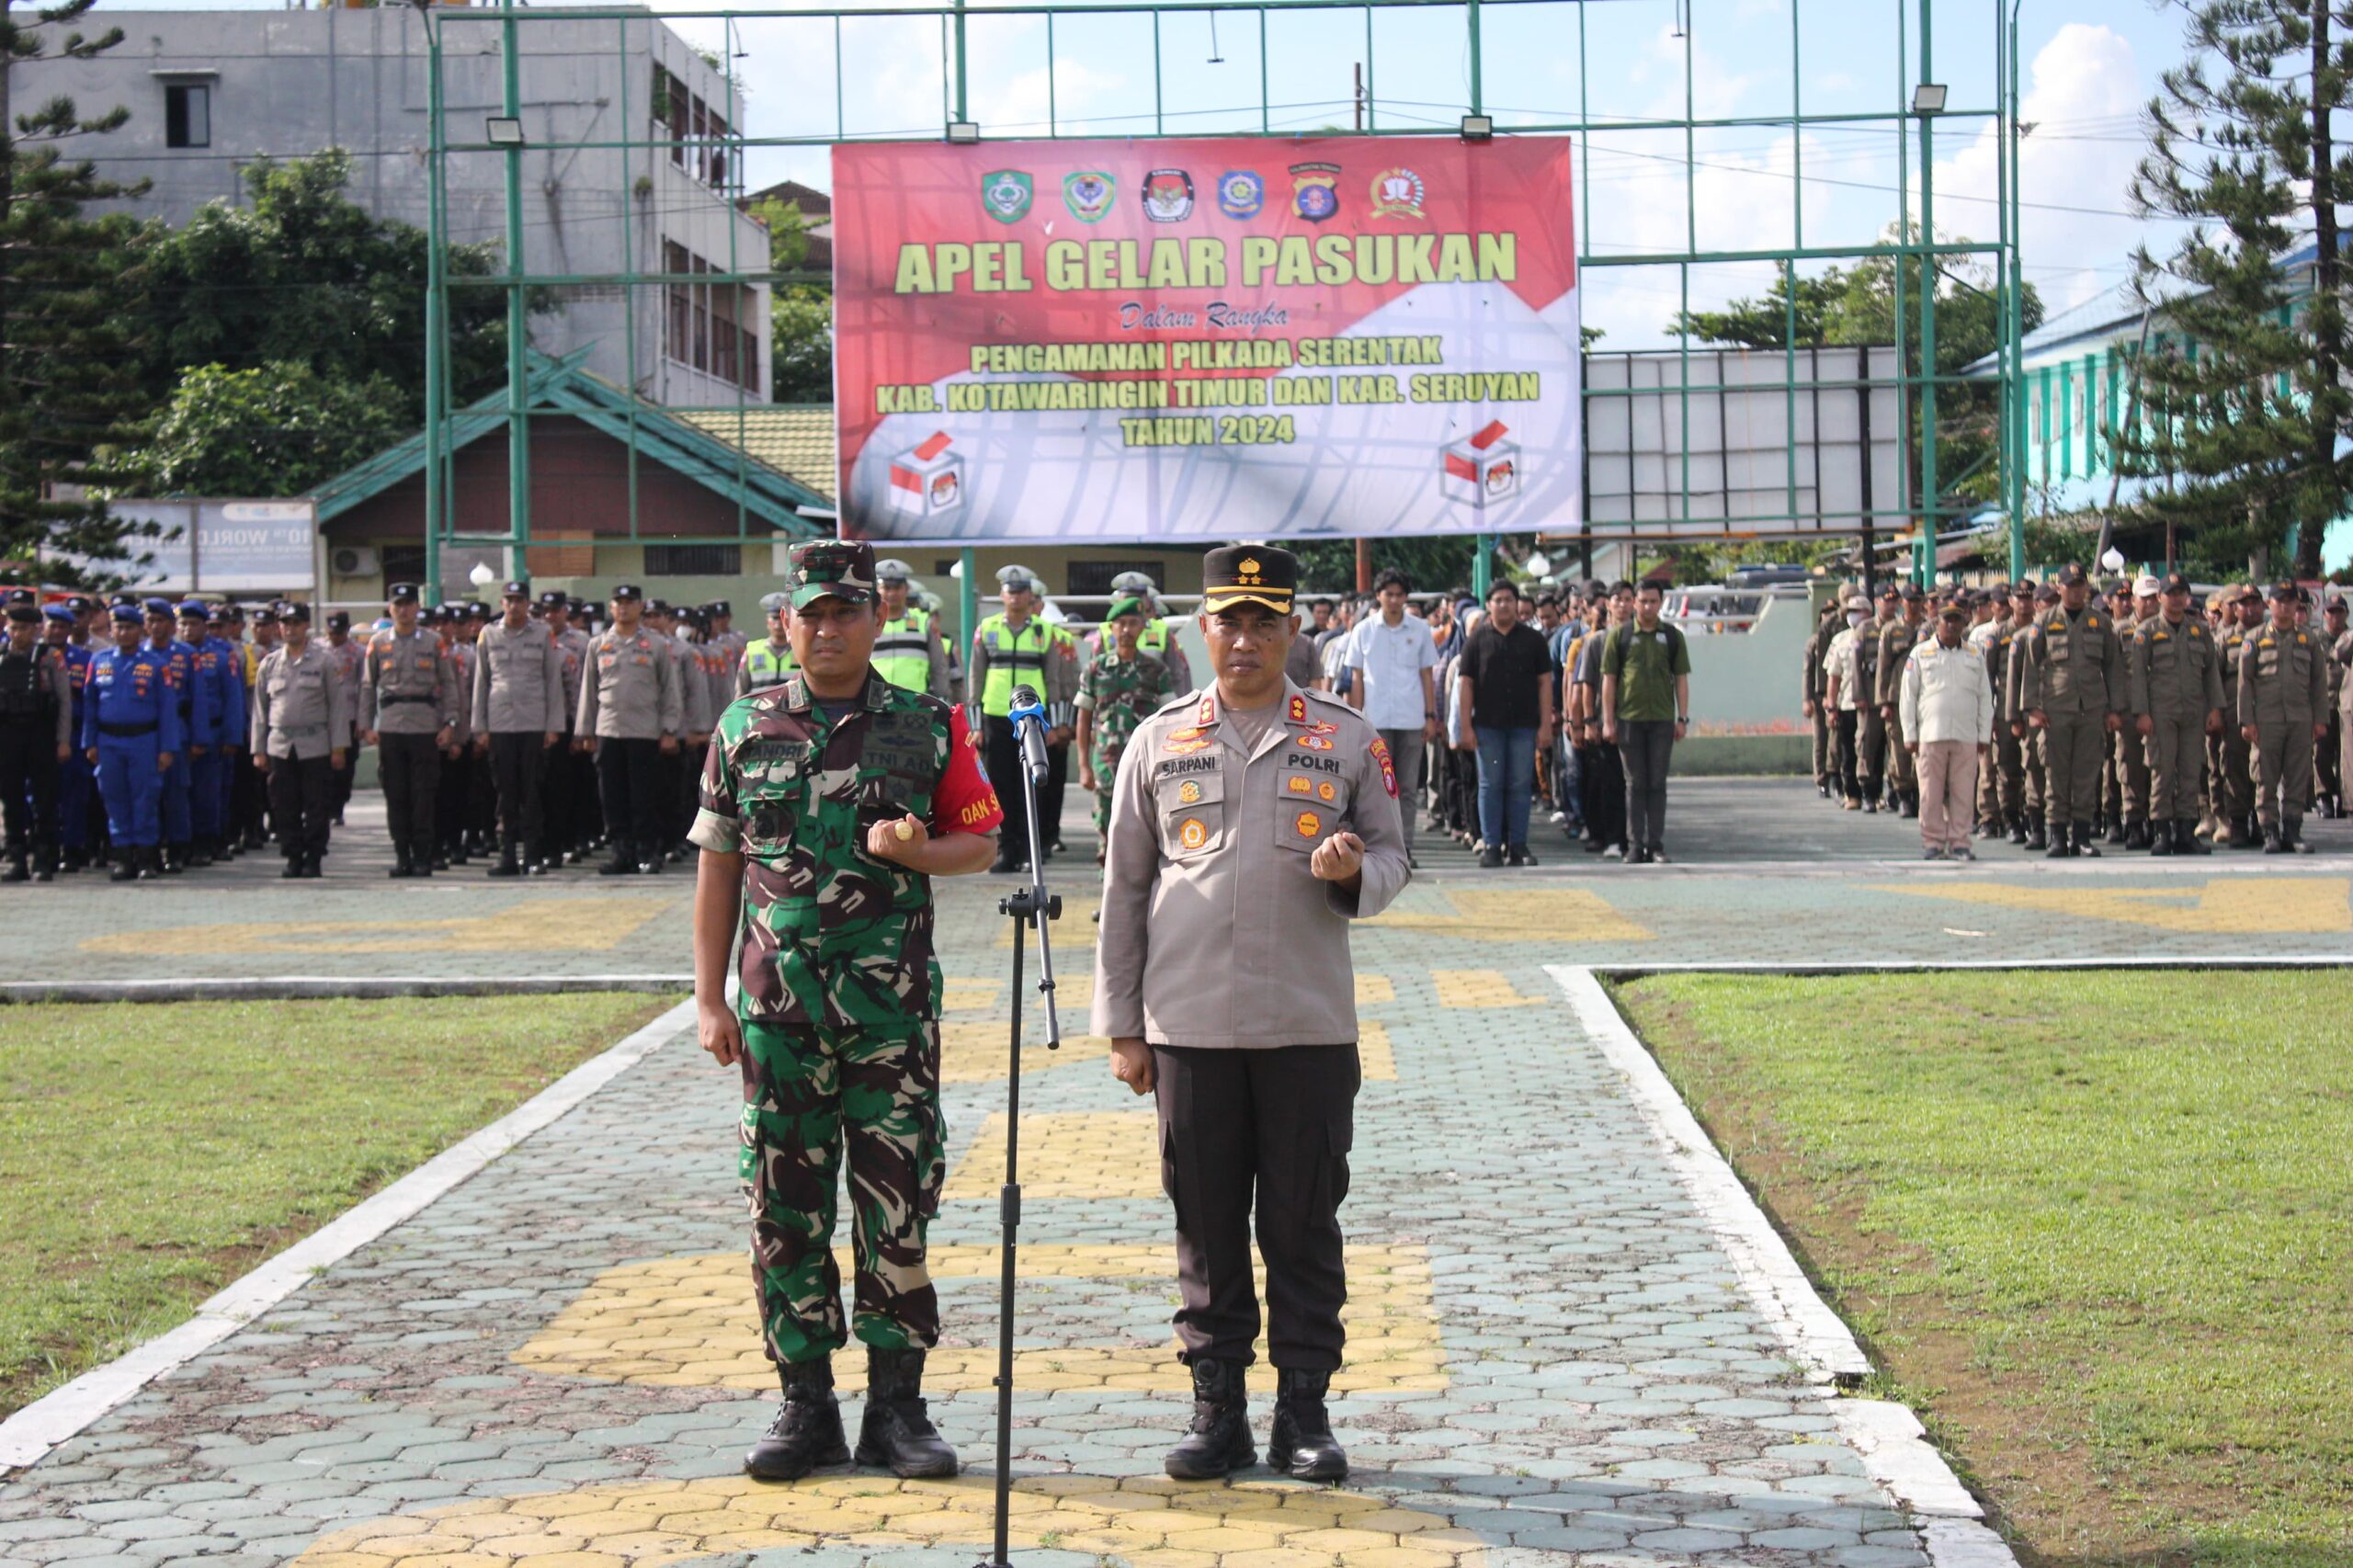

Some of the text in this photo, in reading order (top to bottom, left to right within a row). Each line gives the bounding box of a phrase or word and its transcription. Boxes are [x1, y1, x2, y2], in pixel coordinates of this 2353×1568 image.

[894, 233, 1516, 293] APEL GELAR PASUKAN
[1120, 301, 1289, 335] Dalam Rangka
[971, 335, 1443, 373] PENGAMANAN PILKADA SERENTAK
[876, 371, 1540, 413] KAB. KOTAWARINGIN TIMUR DAN KAB. SERUYAN
[1120, 415, 1295, 447] TAHUN 2024
[867, 752, 930, 772] TNI AD
[1162, 756, 1215, 776] SARPANI
[1288, 754, 1339, 774] POLRI
